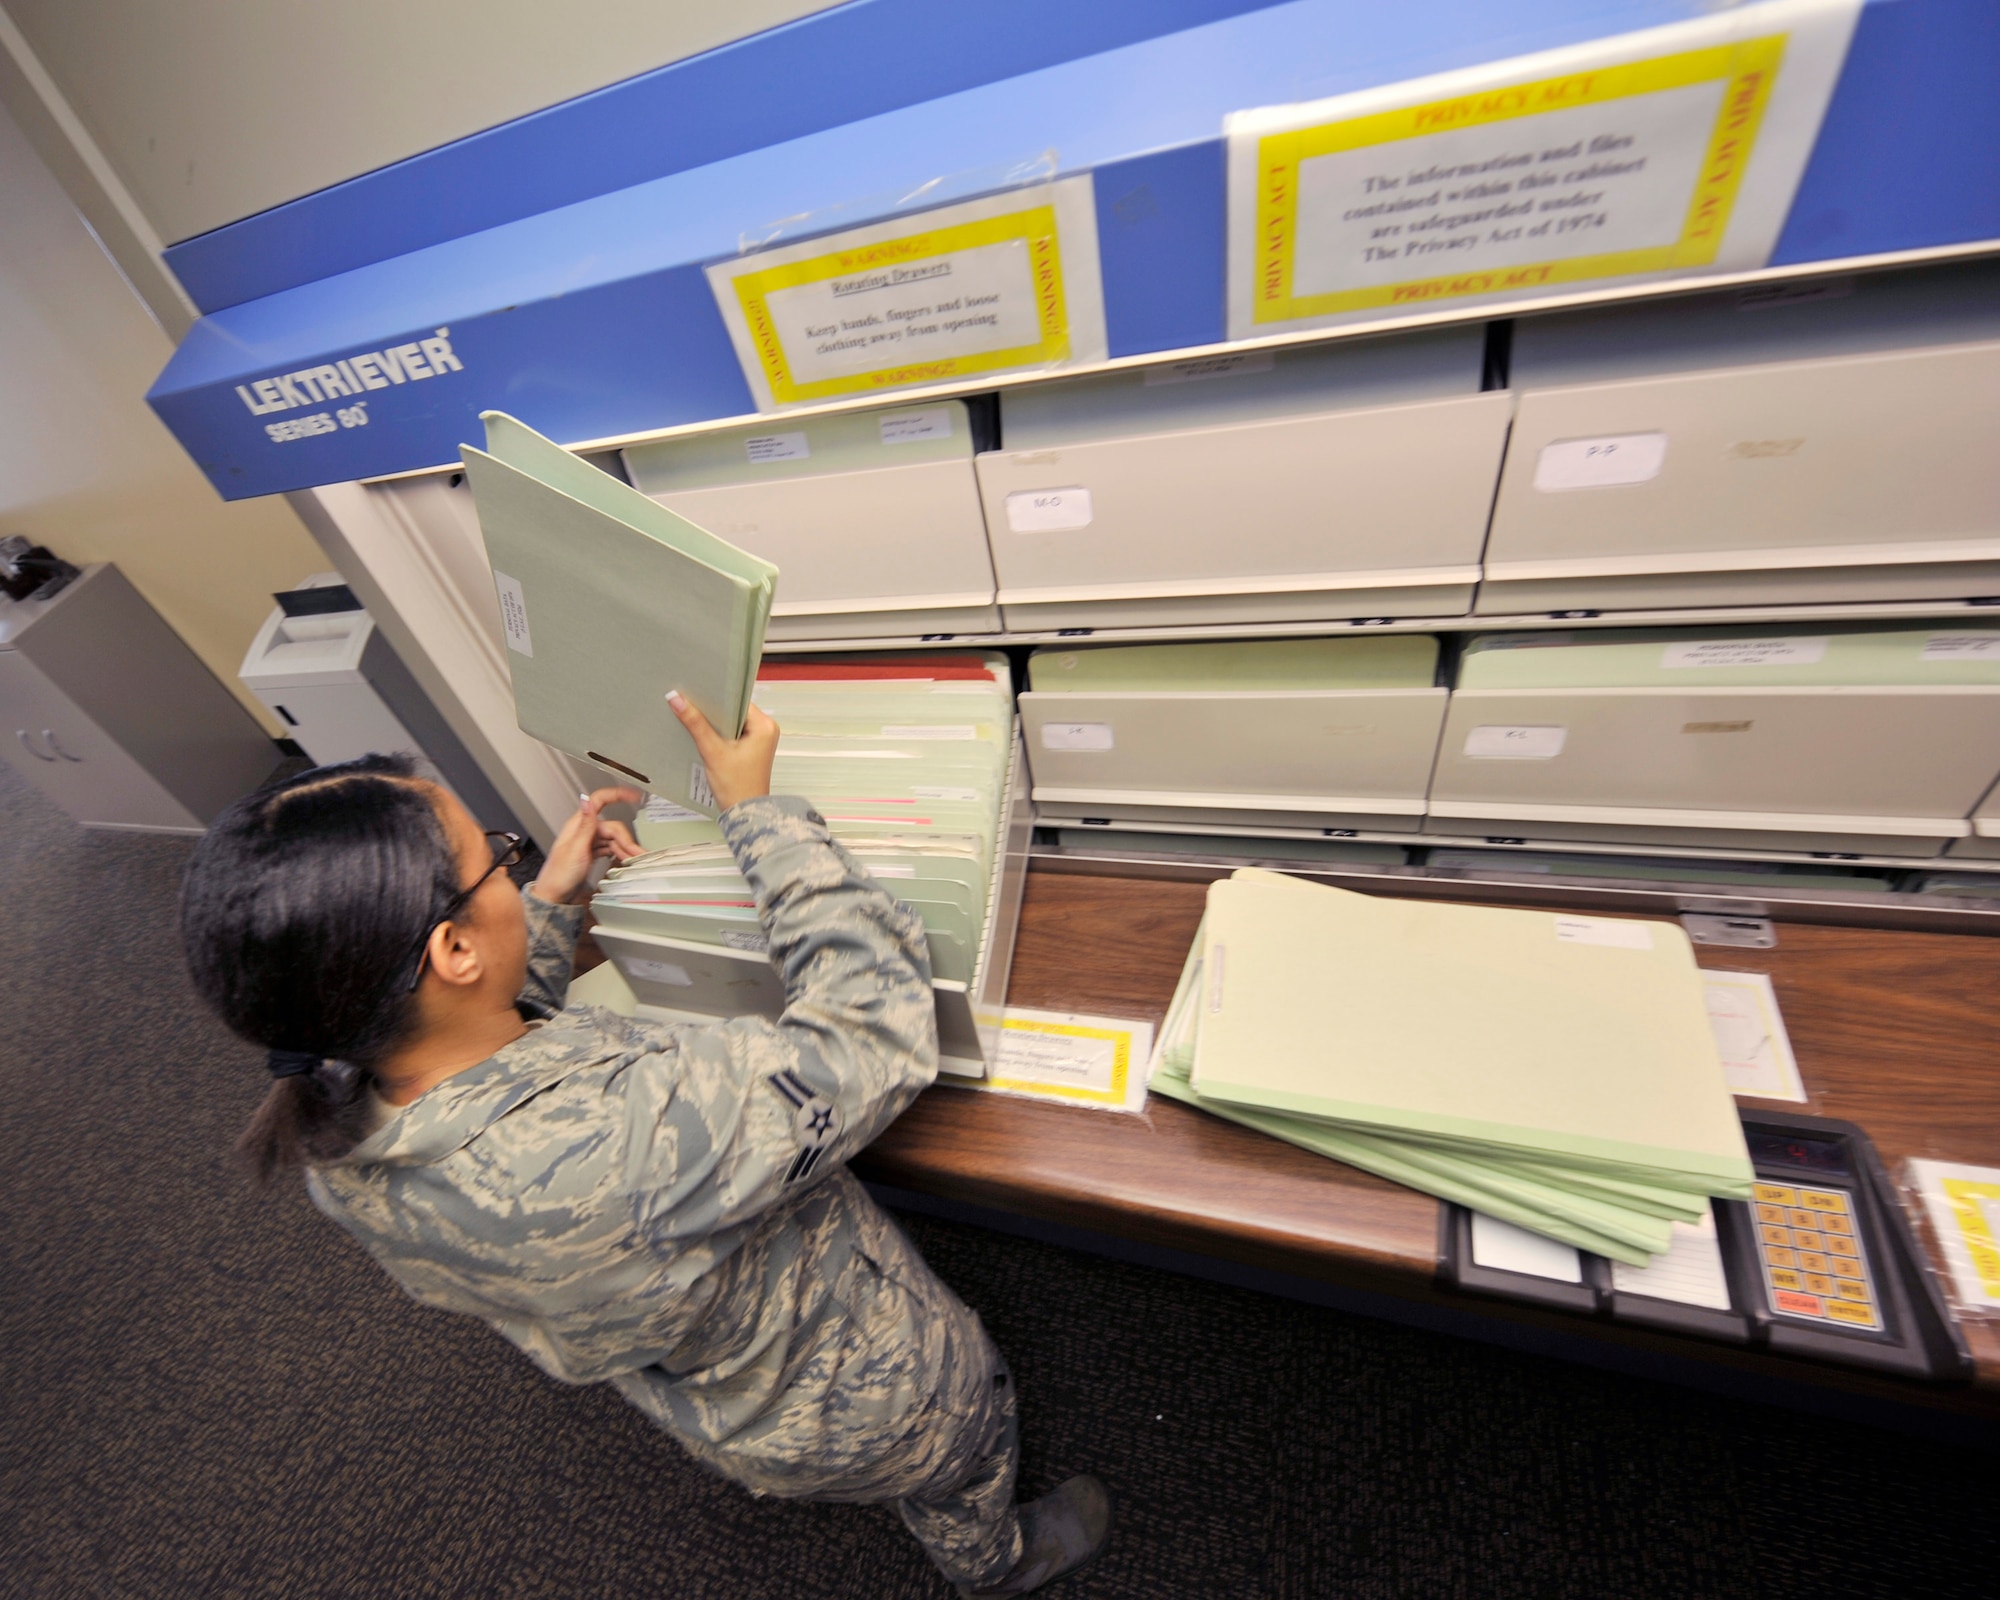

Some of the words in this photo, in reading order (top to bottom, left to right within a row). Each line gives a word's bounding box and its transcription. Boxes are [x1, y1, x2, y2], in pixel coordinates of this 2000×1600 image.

[1413, 88, 1532, 131] PRIVACY
[1542, 75, 1597, 101] ACT
[1706, 69, 1765, 184] PRIVACY
[1269, 164, 1288, 204] ACT
[1342, 190, 1441, 221] contained
[1446, 176, 1511, 201] within
[1518, 168, 1558, 191] this
[1563, 156, 1647, 184] cabinet
[1363, 176, 1401, 194] The
[1406, 152, 1533, 188] information
[1539, 140, 1583, 163] and
[1588, 134, 1635, 155] files
[1363, 246, 1398, 264] The
[1404, 234, 1478, 257] Privacy
[1486, 227, 1523, 244] Act
[1526, 220, 1552, 238] of
[1556, 212, 1608, 235] 1974
[1370, 225, 1402, 240] are
[1408, 199, 1534, 232] safeguarded
[1538, 191, 1604, 212] under
[1689, 196, 1721, 239] ACT
[831, 275, 889, 295] Rotating
[892, 261, 952, 283] Drawers
[1265, 215, 1287, 302] PRIVACY
[1392, 274, 1494, 302] PRIVACY
[1501, 264, 1554, 286] ACT
[805, 323, 839, 341] Keep
[886, 305, 932, 325] fingers
[936, 294, 962, 312] and
[964, 293, 1001, 310] loose
[816, 336, 868, 356] clothing
[870, 331, 903, 346] away
[905, 323, 939, 338] from
[941, 312, 998, 334] opening
[234, 335, 463, 416] LEKTRIEVER
[265, 412, 338, 443] SERIES
[336, 405, 369, 429] 80
